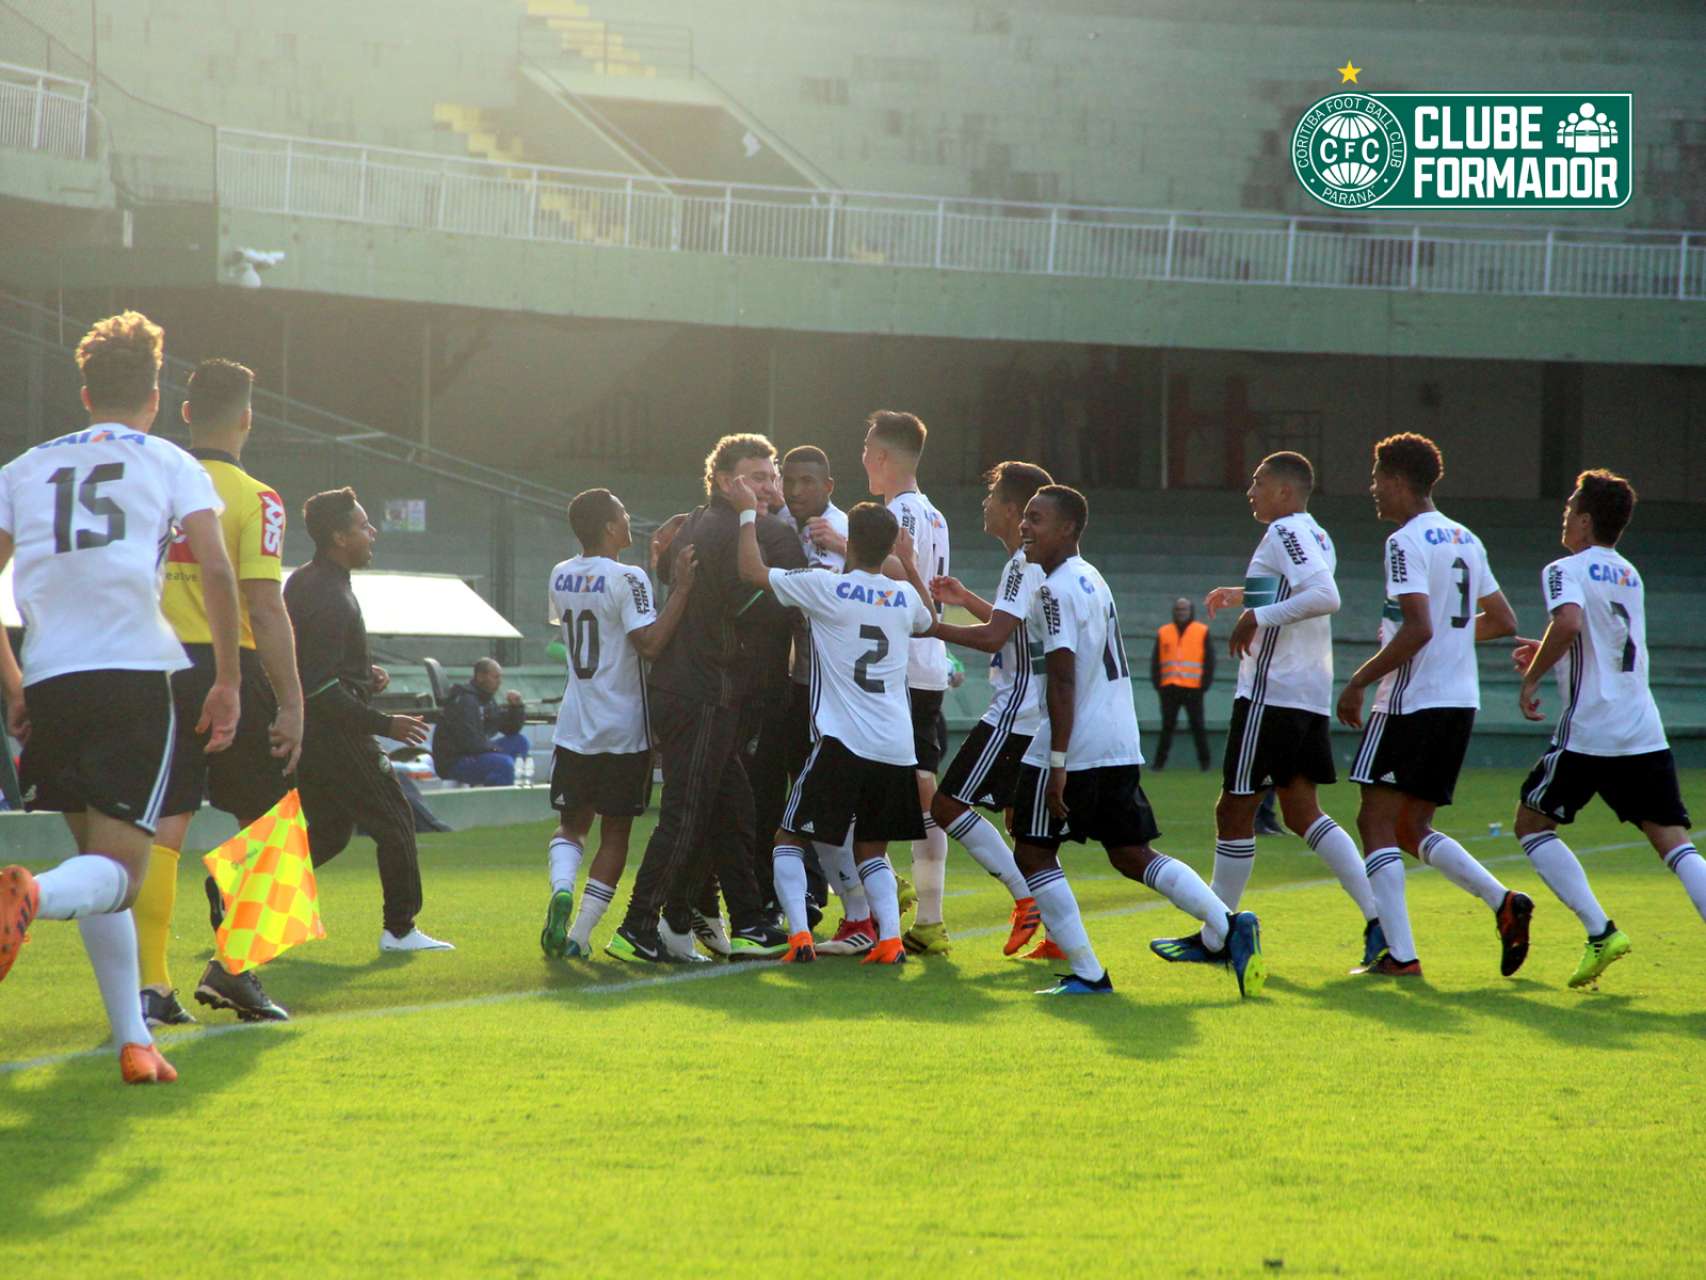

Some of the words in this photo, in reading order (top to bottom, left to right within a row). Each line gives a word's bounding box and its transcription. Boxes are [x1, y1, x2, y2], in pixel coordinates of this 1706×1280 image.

[38, 430, 146, 449] AIXA
[46, 462, 126, 554] 15
[1425, 527, 1475, 545] CAIXA
[555, 573, 607, 594] CAIXA
[836, 582, 908, 608] CAIXA
[1450, 556, 1471, 629] 3
[562, 608, 600, 681] 10
[853, 624, 890, 694] 2
